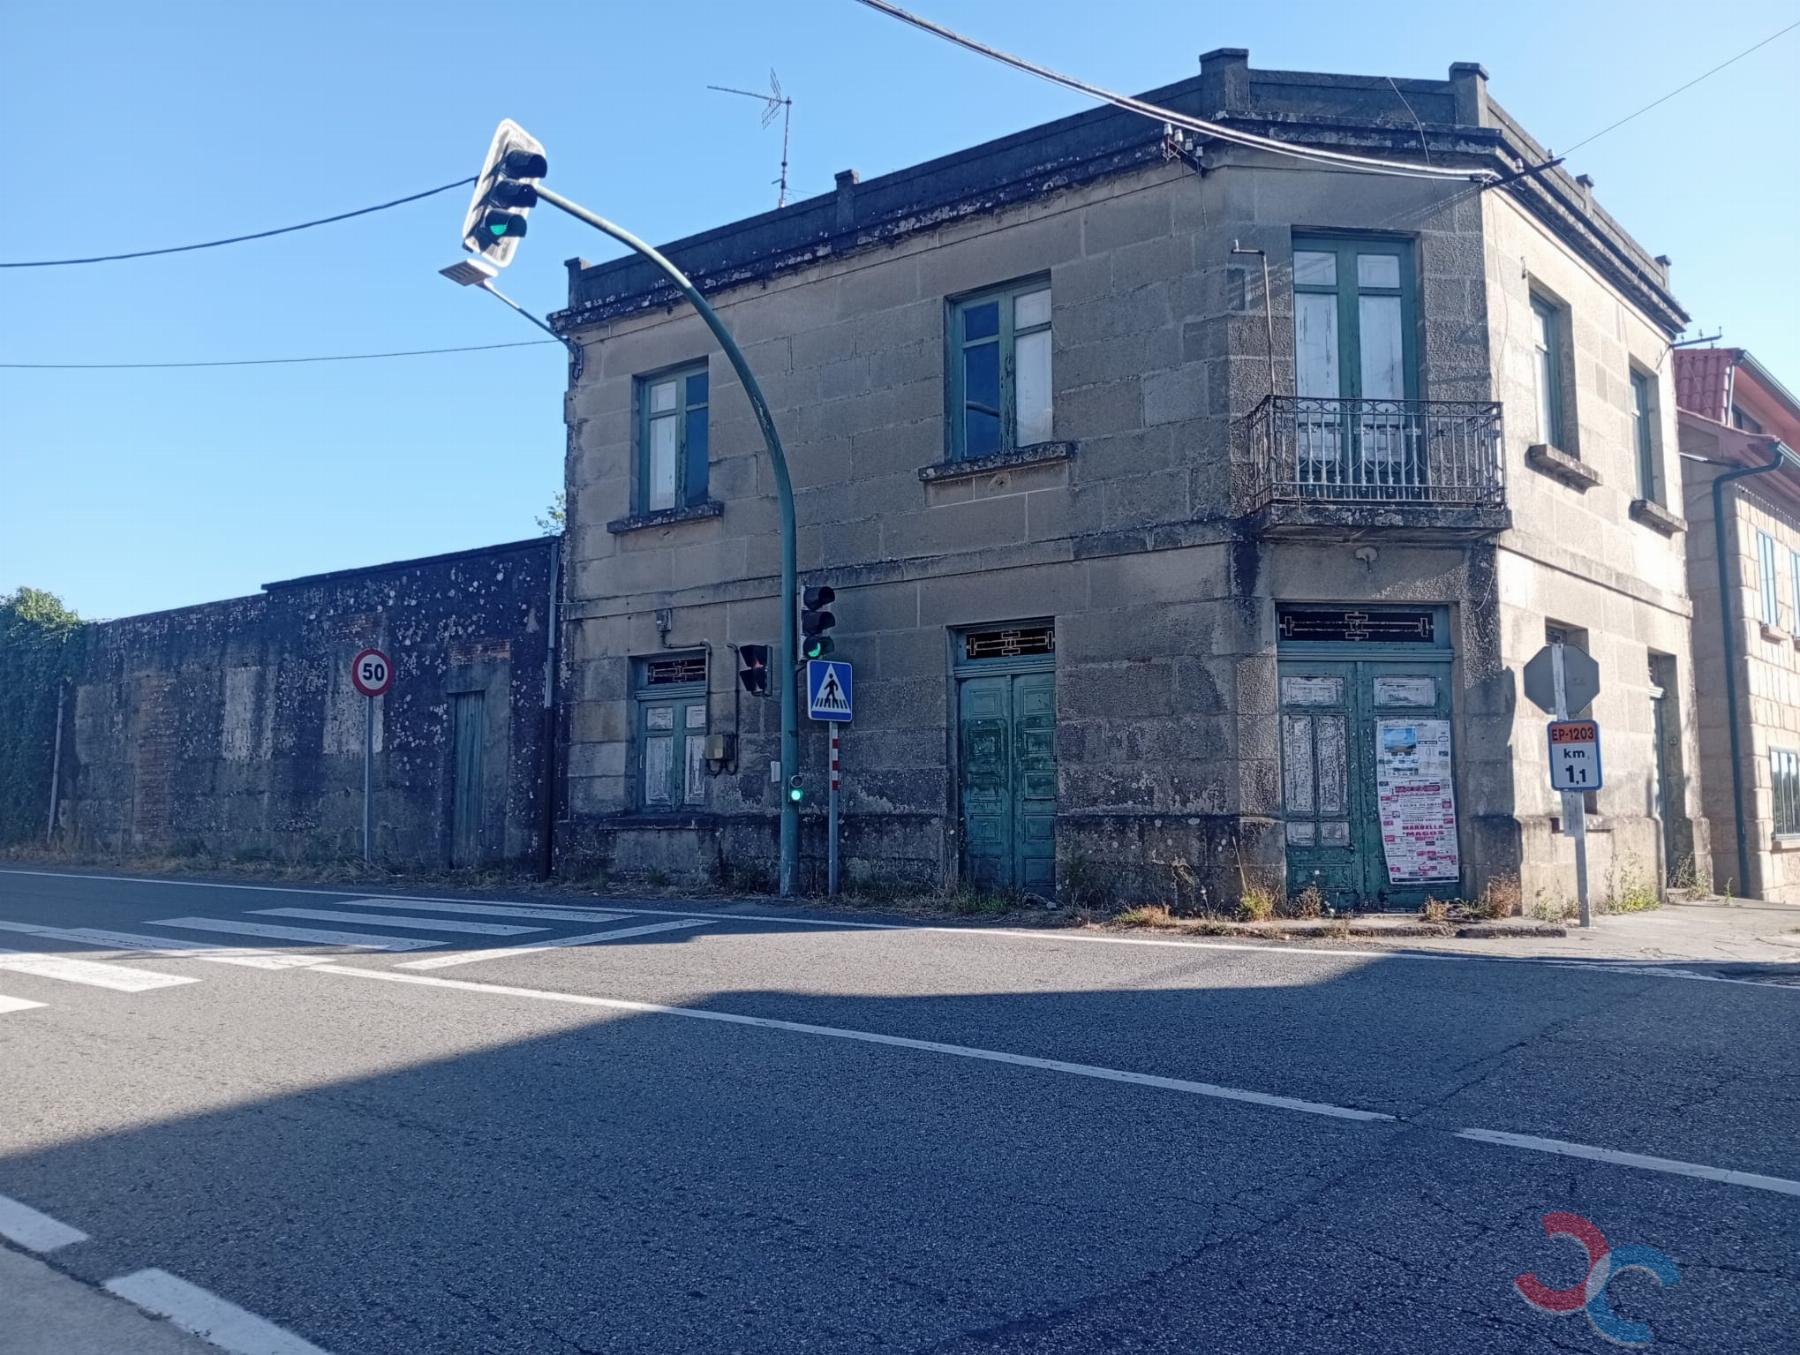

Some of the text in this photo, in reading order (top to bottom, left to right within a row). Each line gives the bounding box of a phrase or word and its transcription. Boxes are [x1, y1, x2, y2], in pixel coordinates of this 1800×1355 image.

[362, 663, 385, 682] 50
[1552, 727, 1594, 741] EP-1203
[1563, 748, 1585, 759] km
